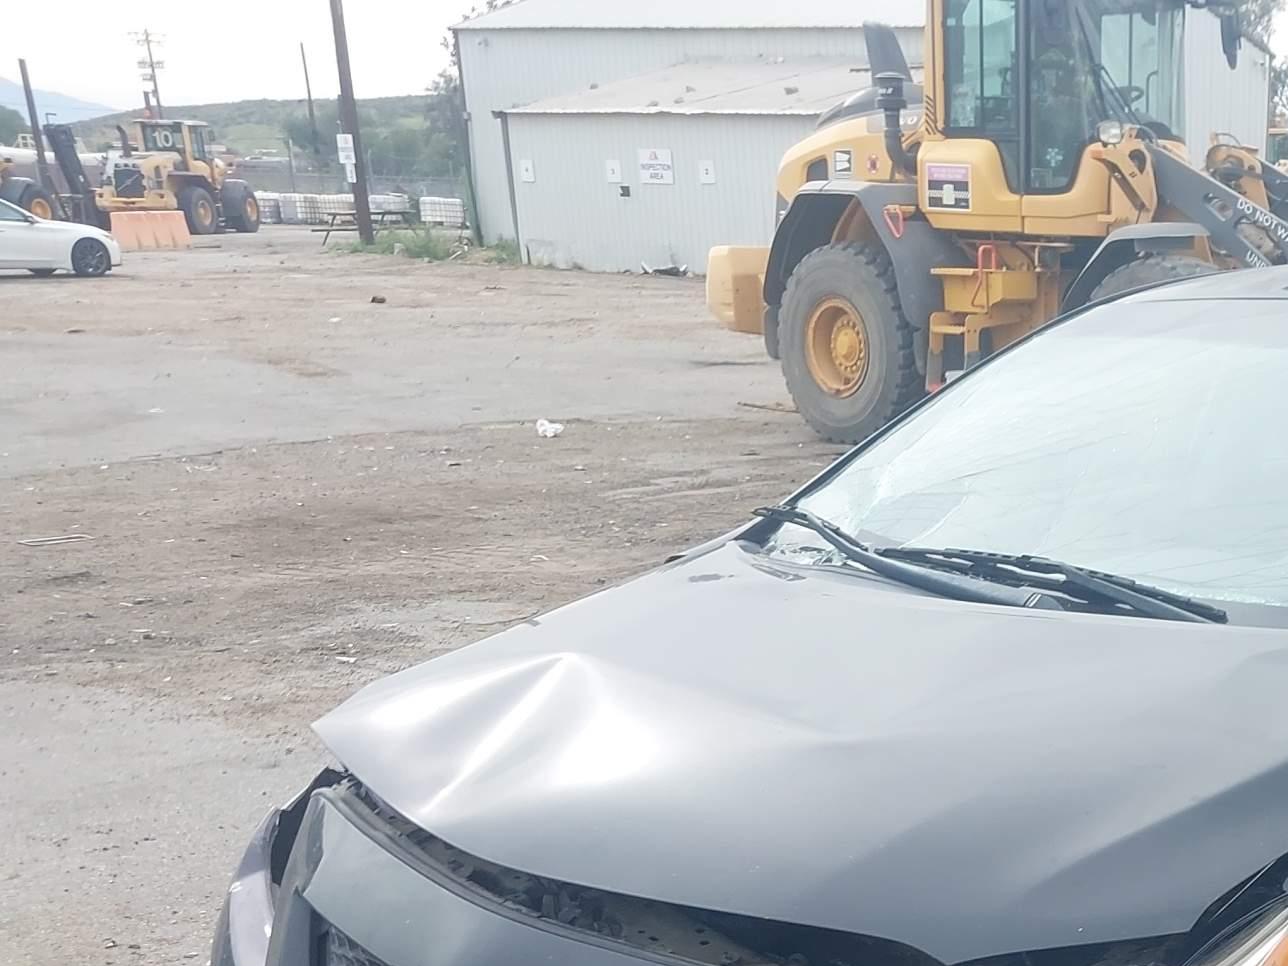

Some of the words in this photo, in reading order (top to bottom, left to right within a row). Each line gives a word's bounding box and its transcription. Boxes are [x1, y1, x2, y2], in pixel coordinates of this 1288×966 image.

[152, 130, 173, 148] 10
[1237, 198, 1253, 214] DO
[1255, 210, 1278, 229] NOT
